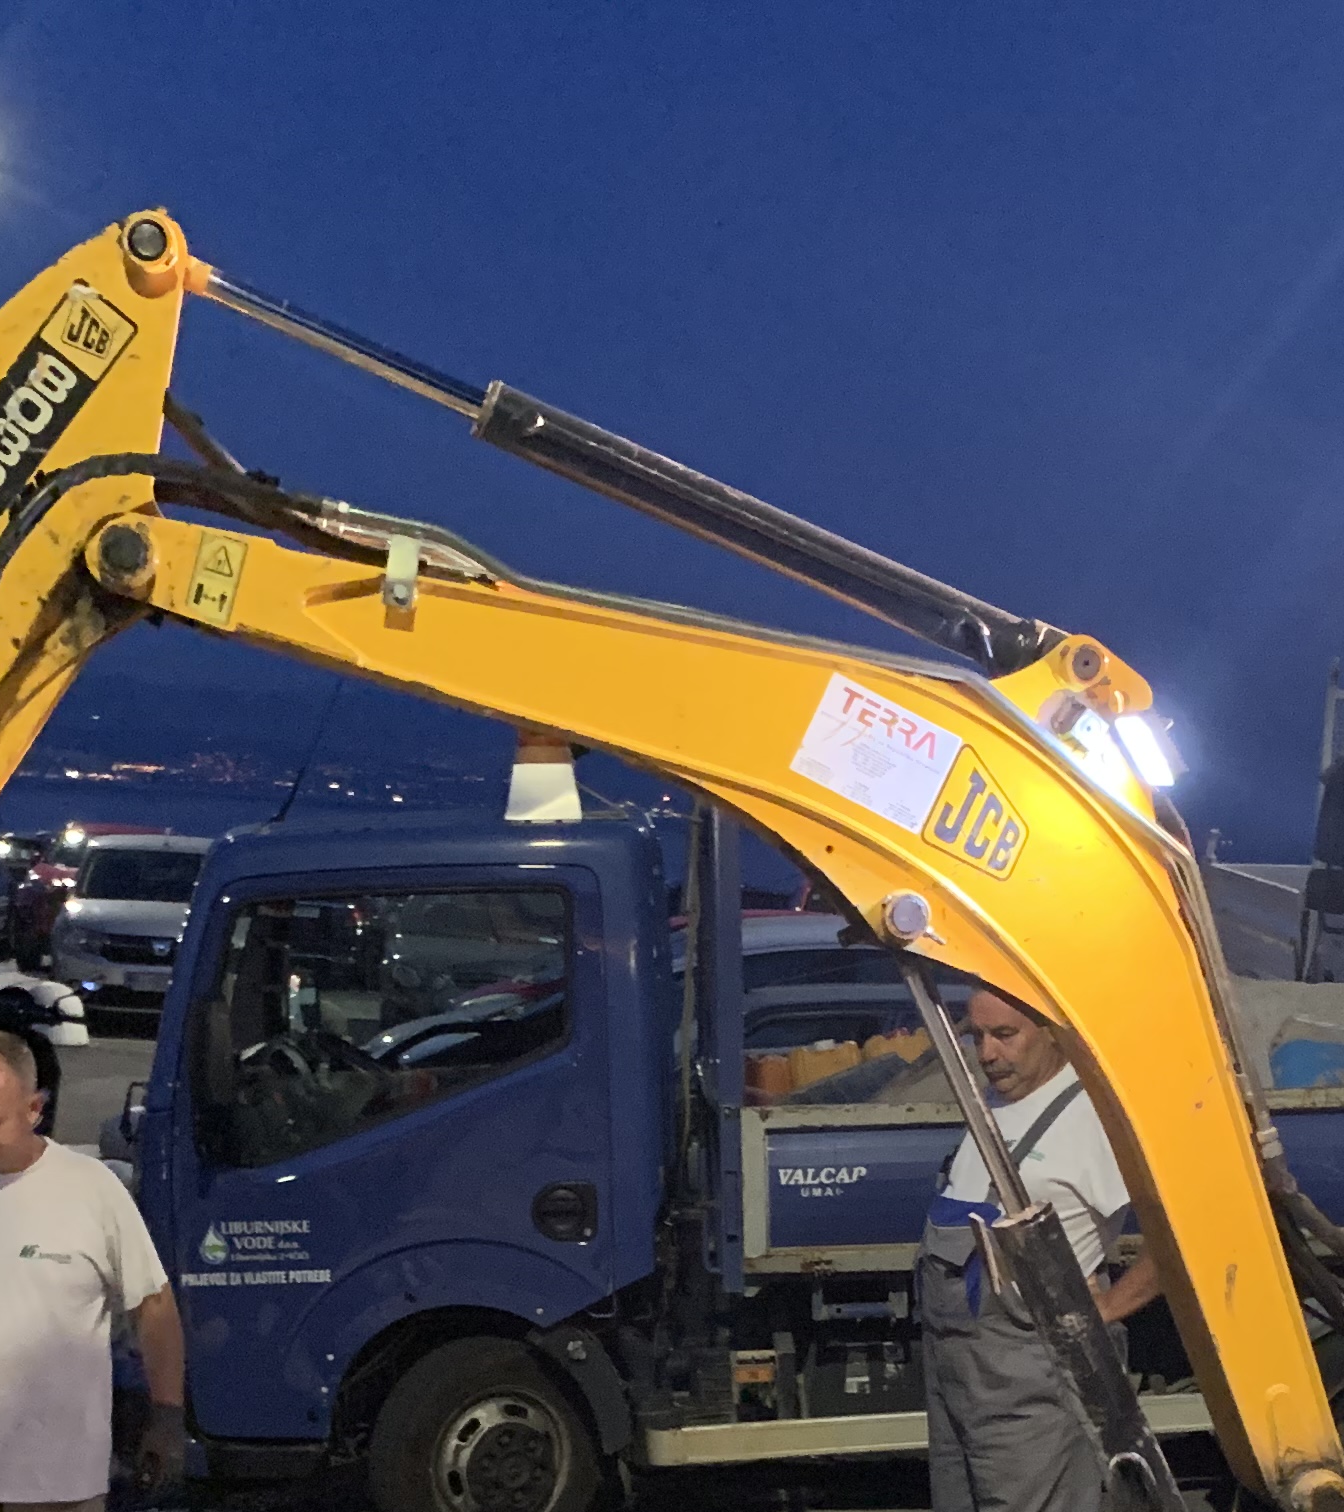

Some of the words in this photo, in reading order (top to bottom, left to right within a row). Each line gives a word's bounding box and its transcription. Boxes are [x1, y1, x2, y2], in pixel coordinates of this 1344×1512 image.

[67, 306, 109, 354] JCB
[842, 686, 936, 760] TERRA
[933, 767, 1021, 872] JCB
[220, 1220, 311, 1236] LIBURNIJSKE
[232, 1236, 276, 1249] VODE
